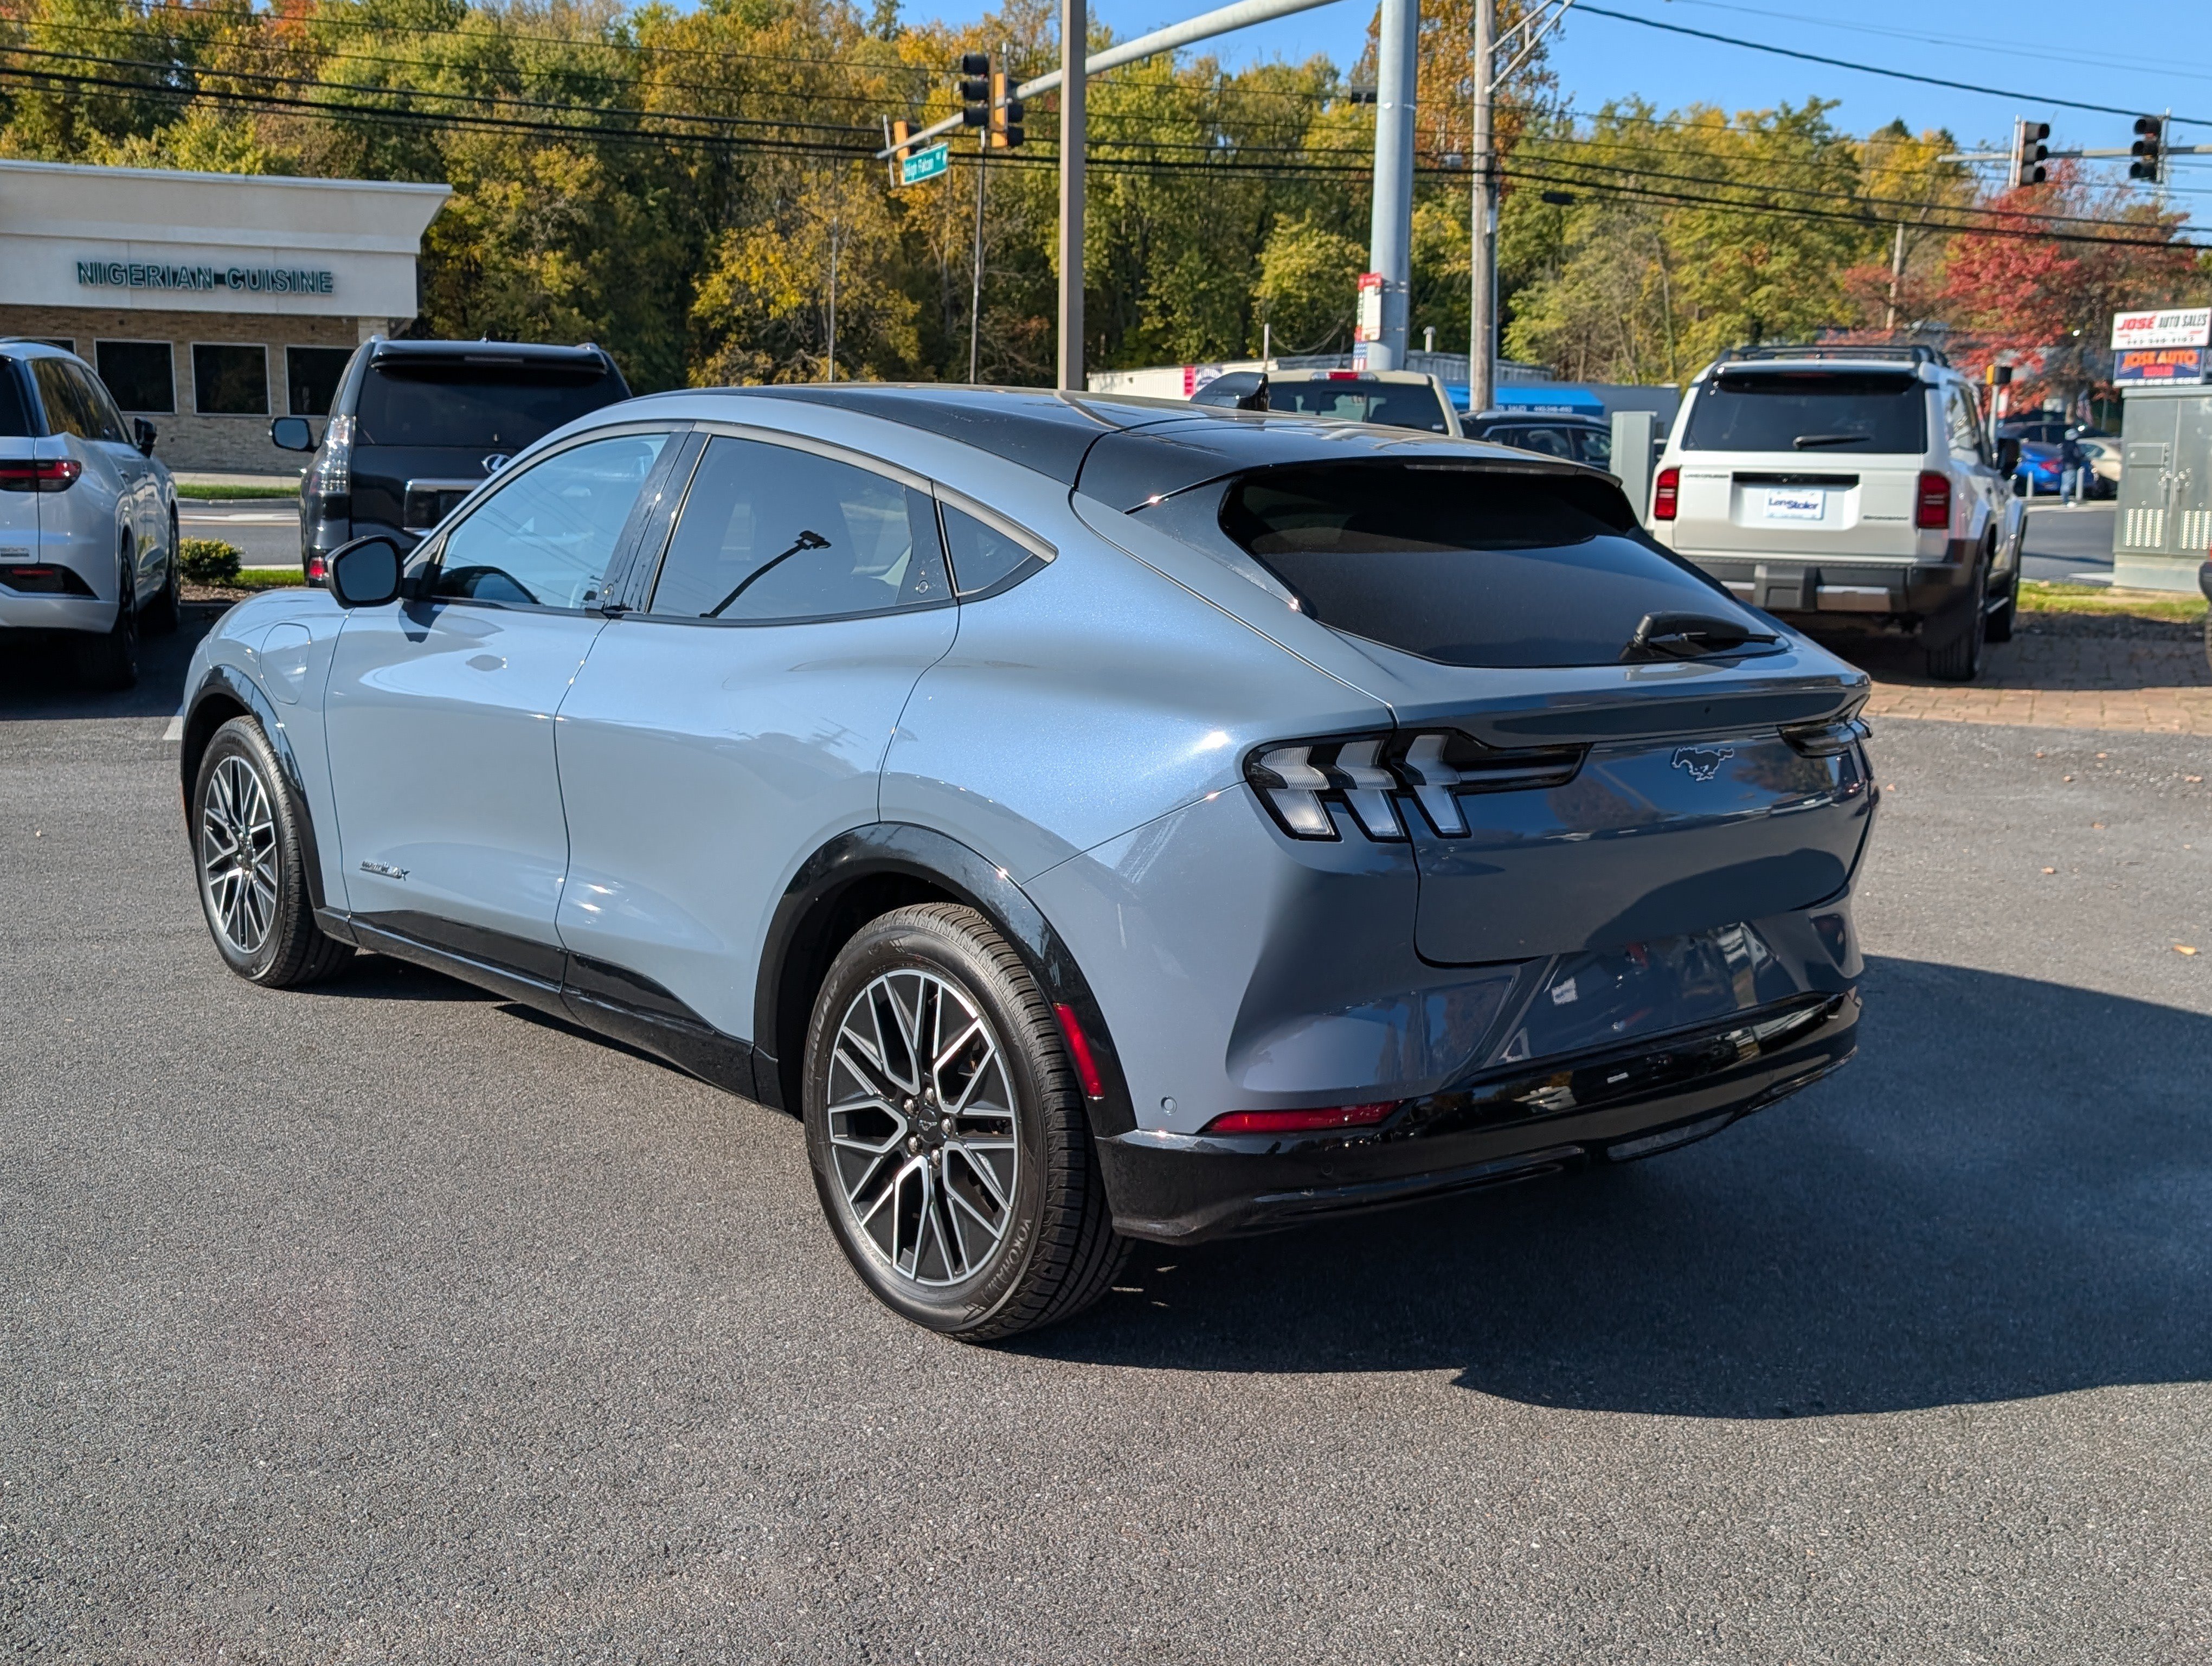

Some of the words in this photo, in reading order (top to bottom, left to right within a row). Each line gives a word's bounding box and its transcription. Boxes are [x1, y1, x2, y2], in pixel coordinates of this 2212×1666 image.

[77, 260, 215, 290] NIGERIAN
[224, 267, 335, 294] CUISINE
[2117, 312, 2157, 331] JOSÉ
[2157, 316, 2180, 329] AUTO
[2181, 313, 2208, 327] SALES
[2156, 349, 2198, 364] AUTO
